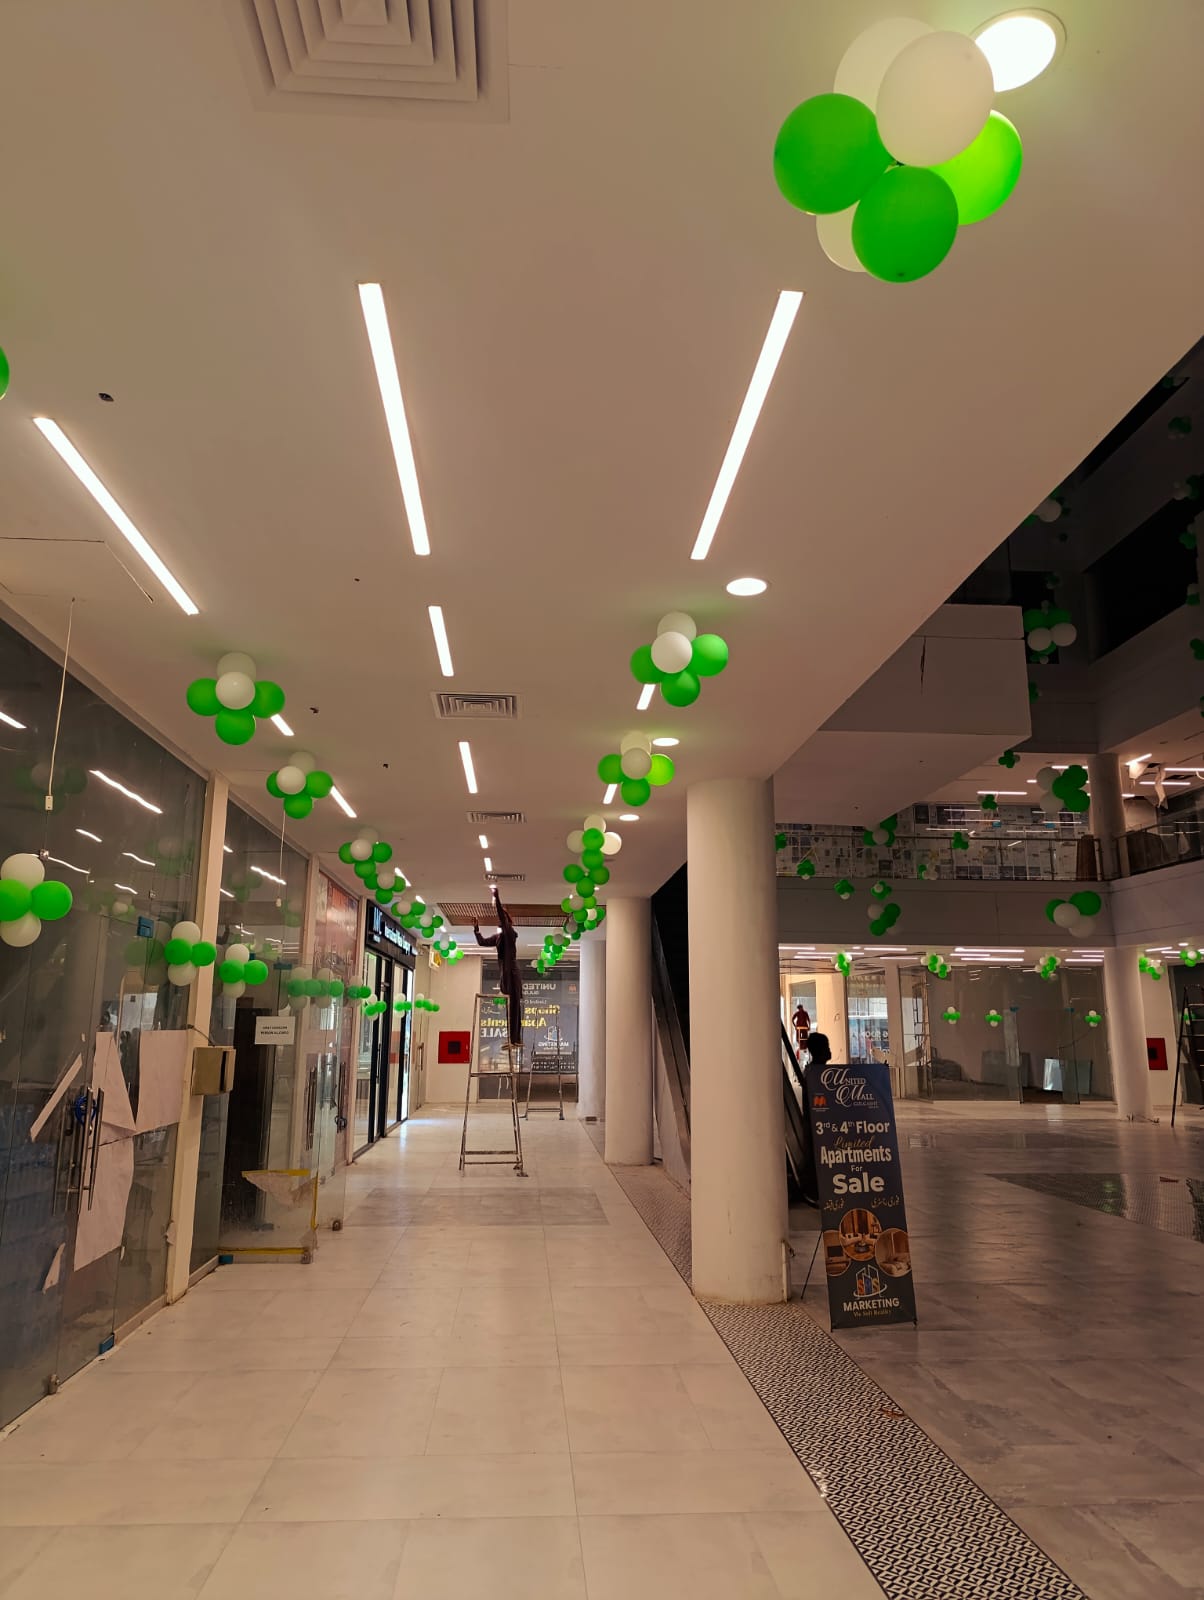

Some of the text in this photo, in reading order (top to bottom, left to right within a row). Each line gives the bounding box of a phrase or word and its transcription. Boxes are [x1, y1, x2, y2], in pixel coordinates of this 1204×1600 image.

[831, 1124, 839, 1132] &
[856, 1121, 890, 1133] Floor
[820, 1145, 892, 1168] Apartments
[833, 1172, 885, 1194] Sale
[843, 1297, 900, 1312] MARKETING
